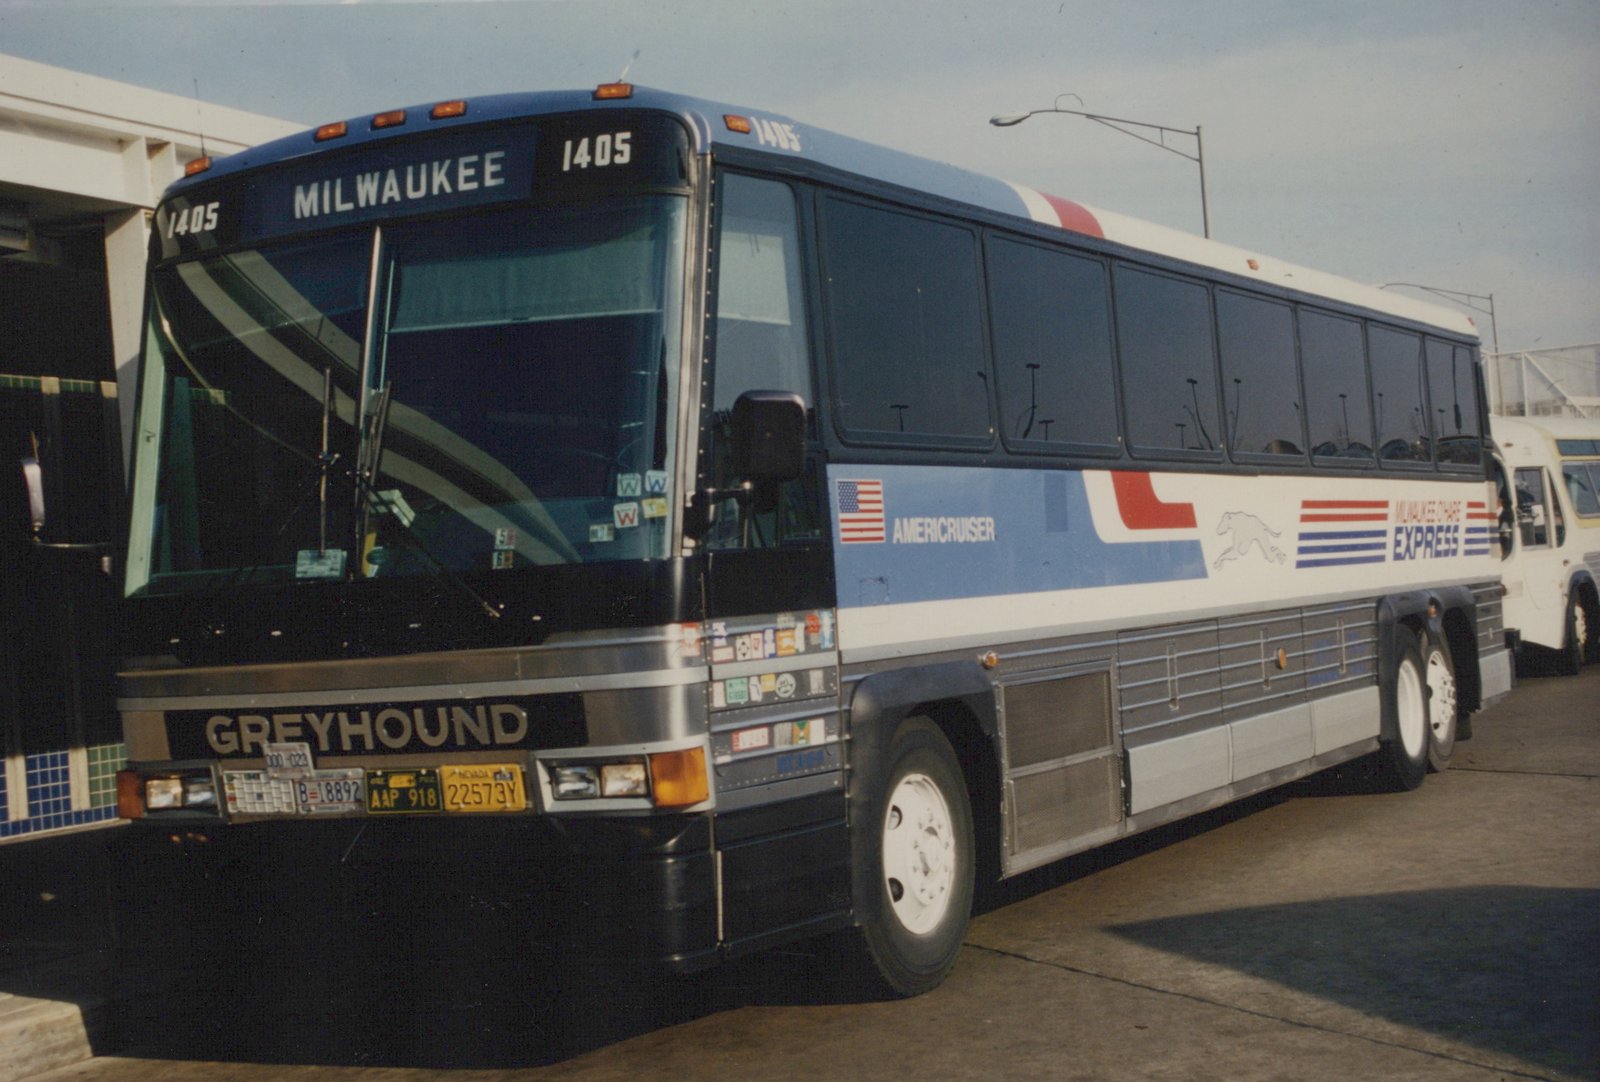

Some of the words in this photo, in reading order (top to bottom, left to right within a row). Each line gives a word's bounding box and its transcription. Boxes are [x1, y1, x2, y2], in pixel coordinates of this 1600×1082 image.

[562, 131, 633, 172] 1405
[749, 116, 801, 152] 1405
[293, 150, 507, 220] MILWAUKEE
[168, 202, 220, 239] 1405
[616, 507, 638, 527] W
[892, 516, 996, 544] AMERICRUISER
[1393, 524, 1460, 561] EXPRESS
[205, 704, 529, 755] GREYHOUND
[408, 787, 438, 807] 918
[448, 781, 517, 805] 22573Y
